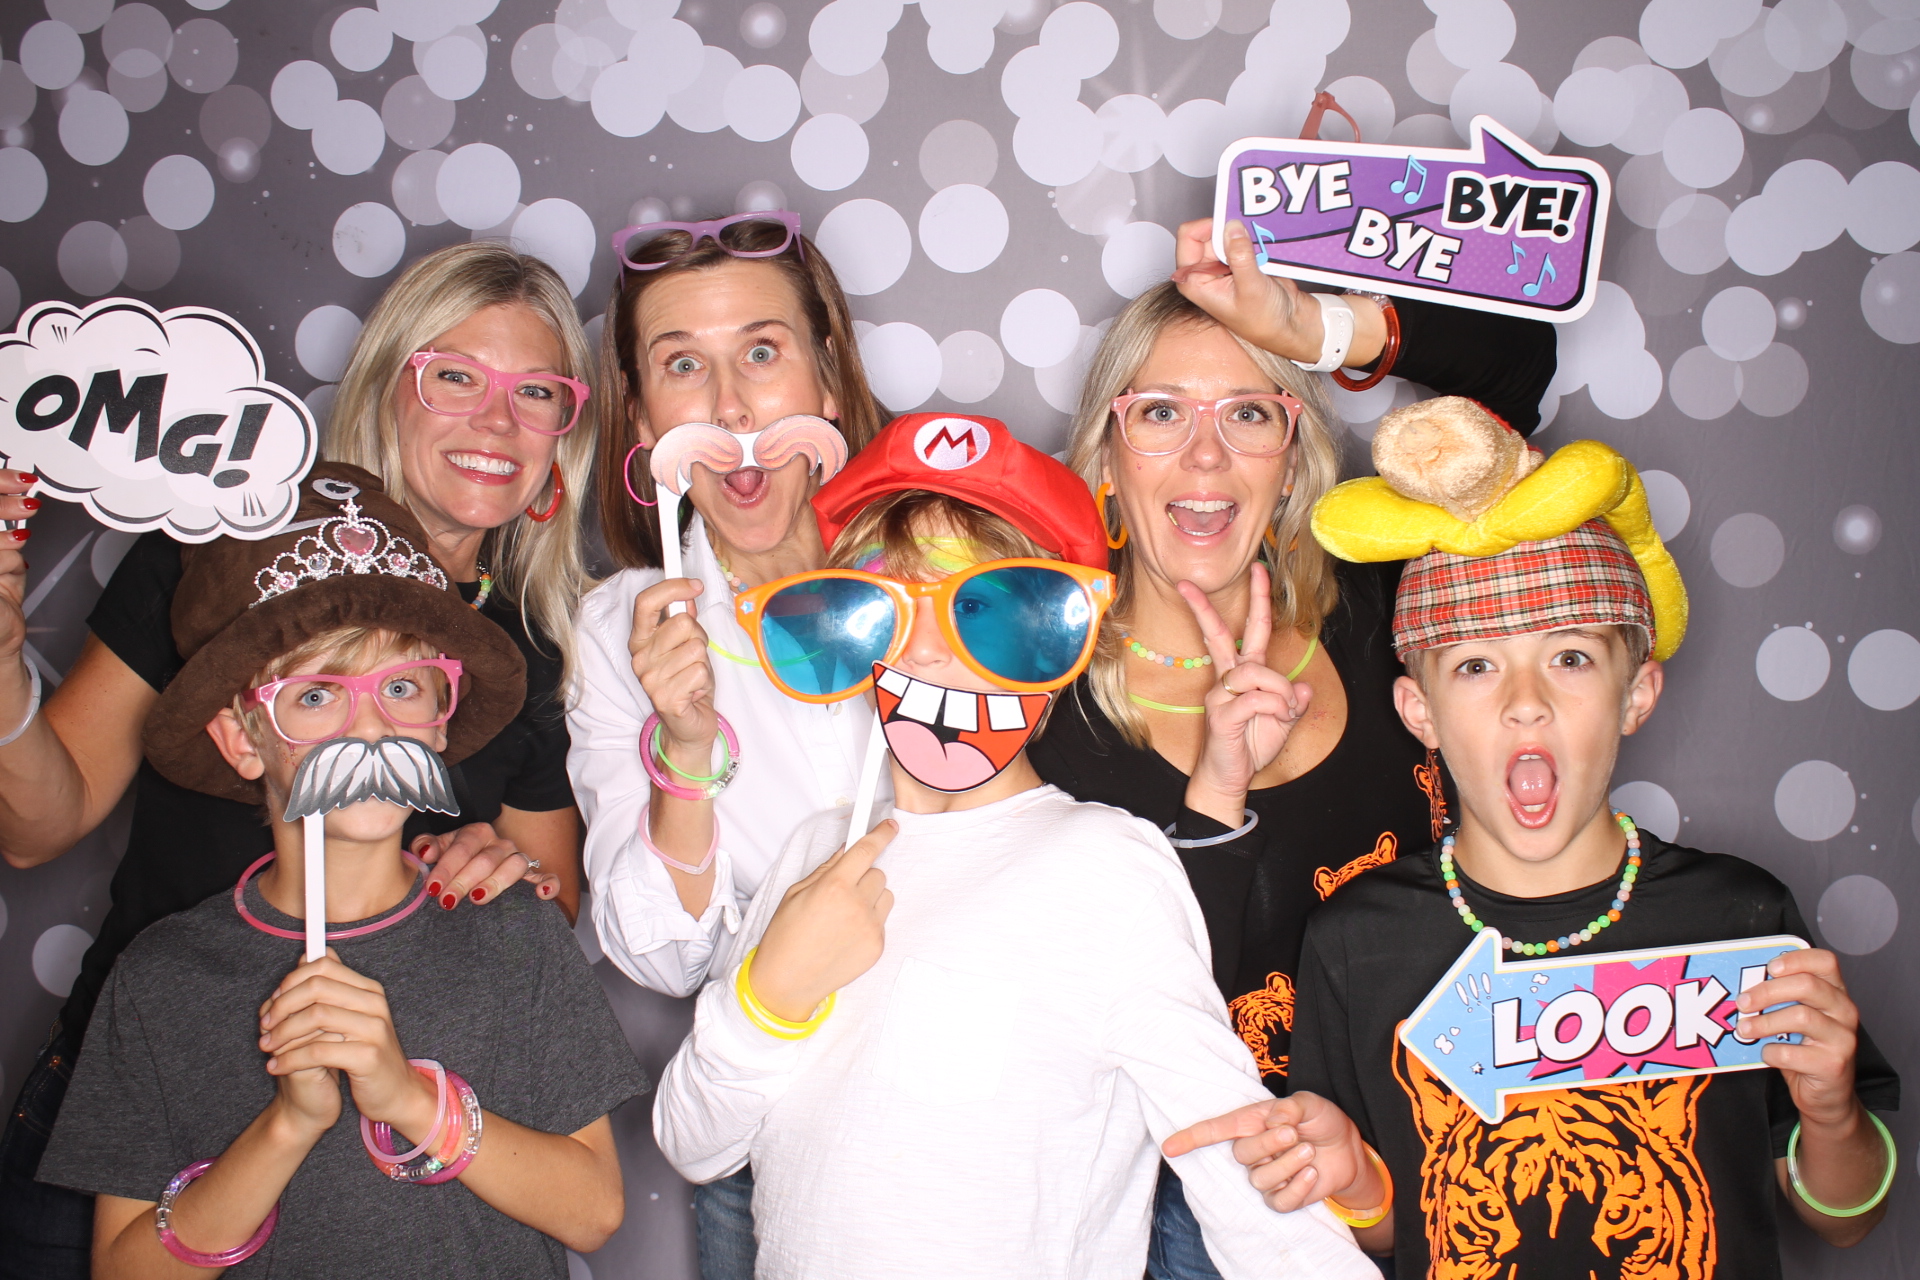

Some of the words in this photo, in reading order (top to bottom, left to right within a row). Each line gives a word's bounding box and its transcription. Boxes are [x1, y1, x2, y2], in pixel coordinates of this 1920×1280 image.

[1238, 160, 1352, 217] BYE
[1446, 174, 1581, 238] BYE!
[1345, 205, 1462, 284] BYE
[16, 368, 274, 489] OMG!
[924, 425, 977, 463] M
